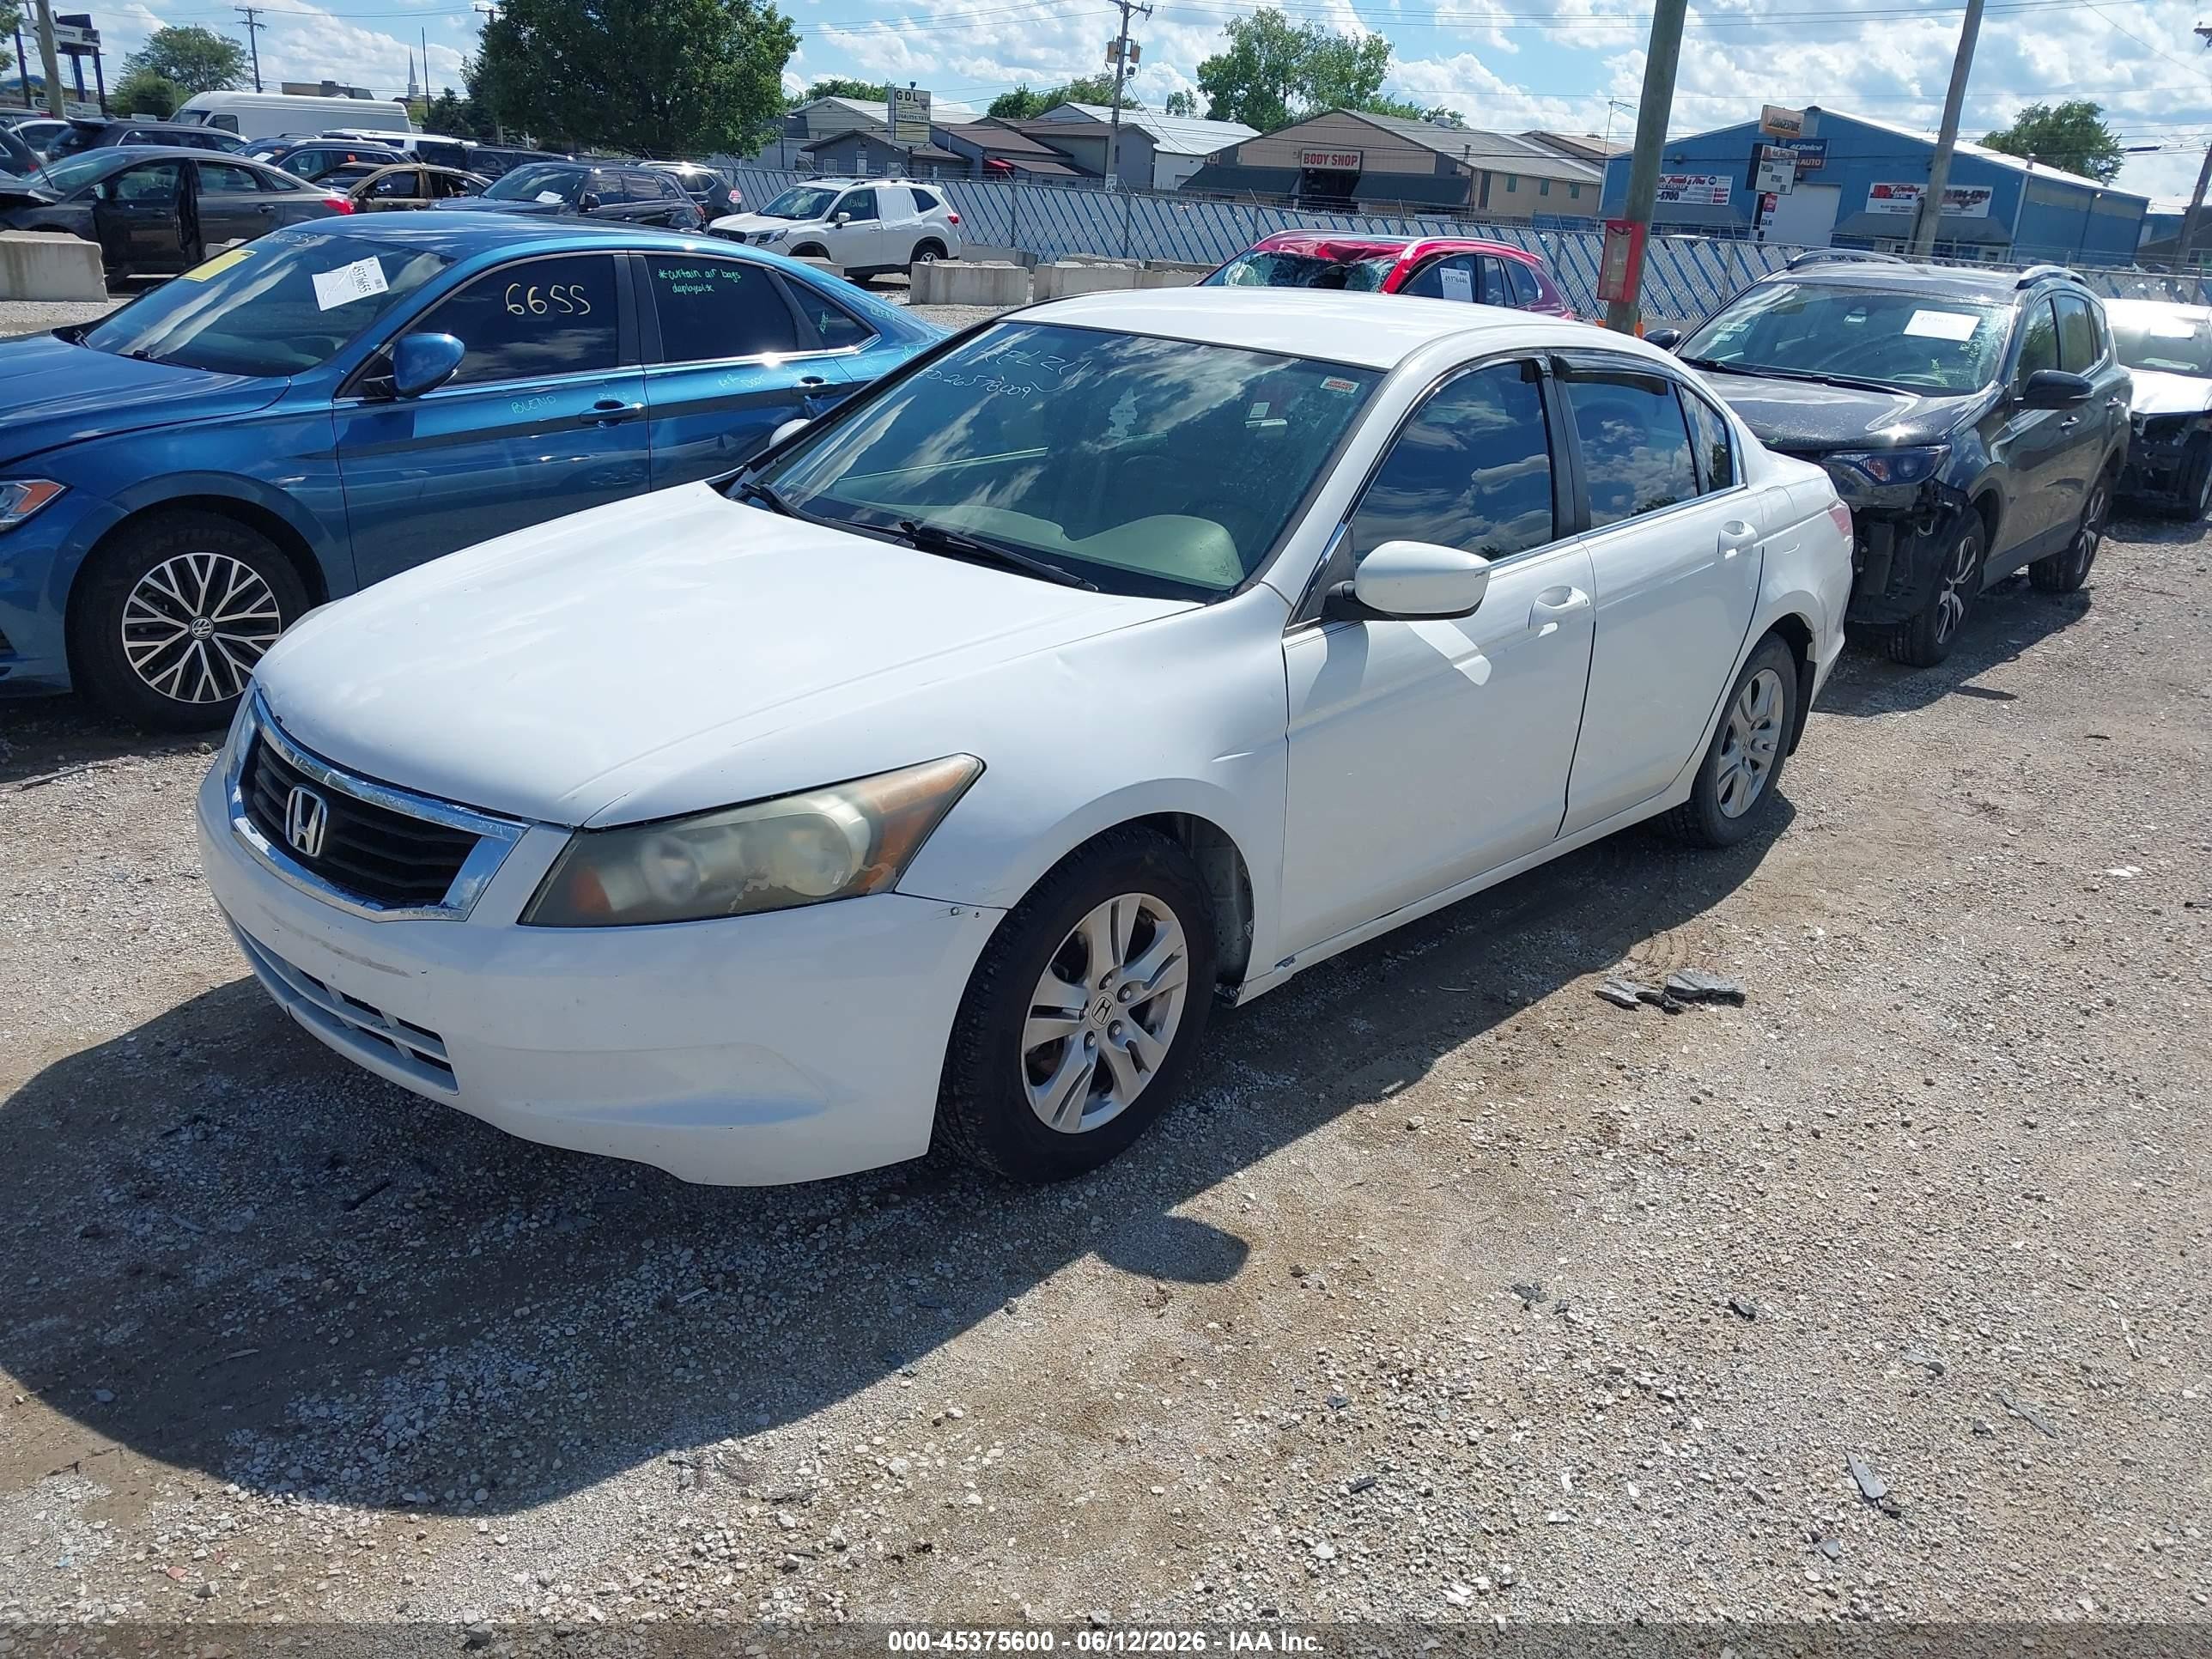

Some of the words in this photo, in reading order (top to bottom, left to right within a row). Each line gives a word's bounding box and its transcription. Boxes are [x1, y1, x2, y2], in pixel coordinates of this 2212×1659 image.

[896, 90, 919, 102] GDL
[1304, 153, 1328, 165] BODY
[1332, 155, 1358, 167] SHOP
[704, 269, 717, 278] air
[720, 269, 742, 283] bags
[505, 283, 591, 315] 6655
